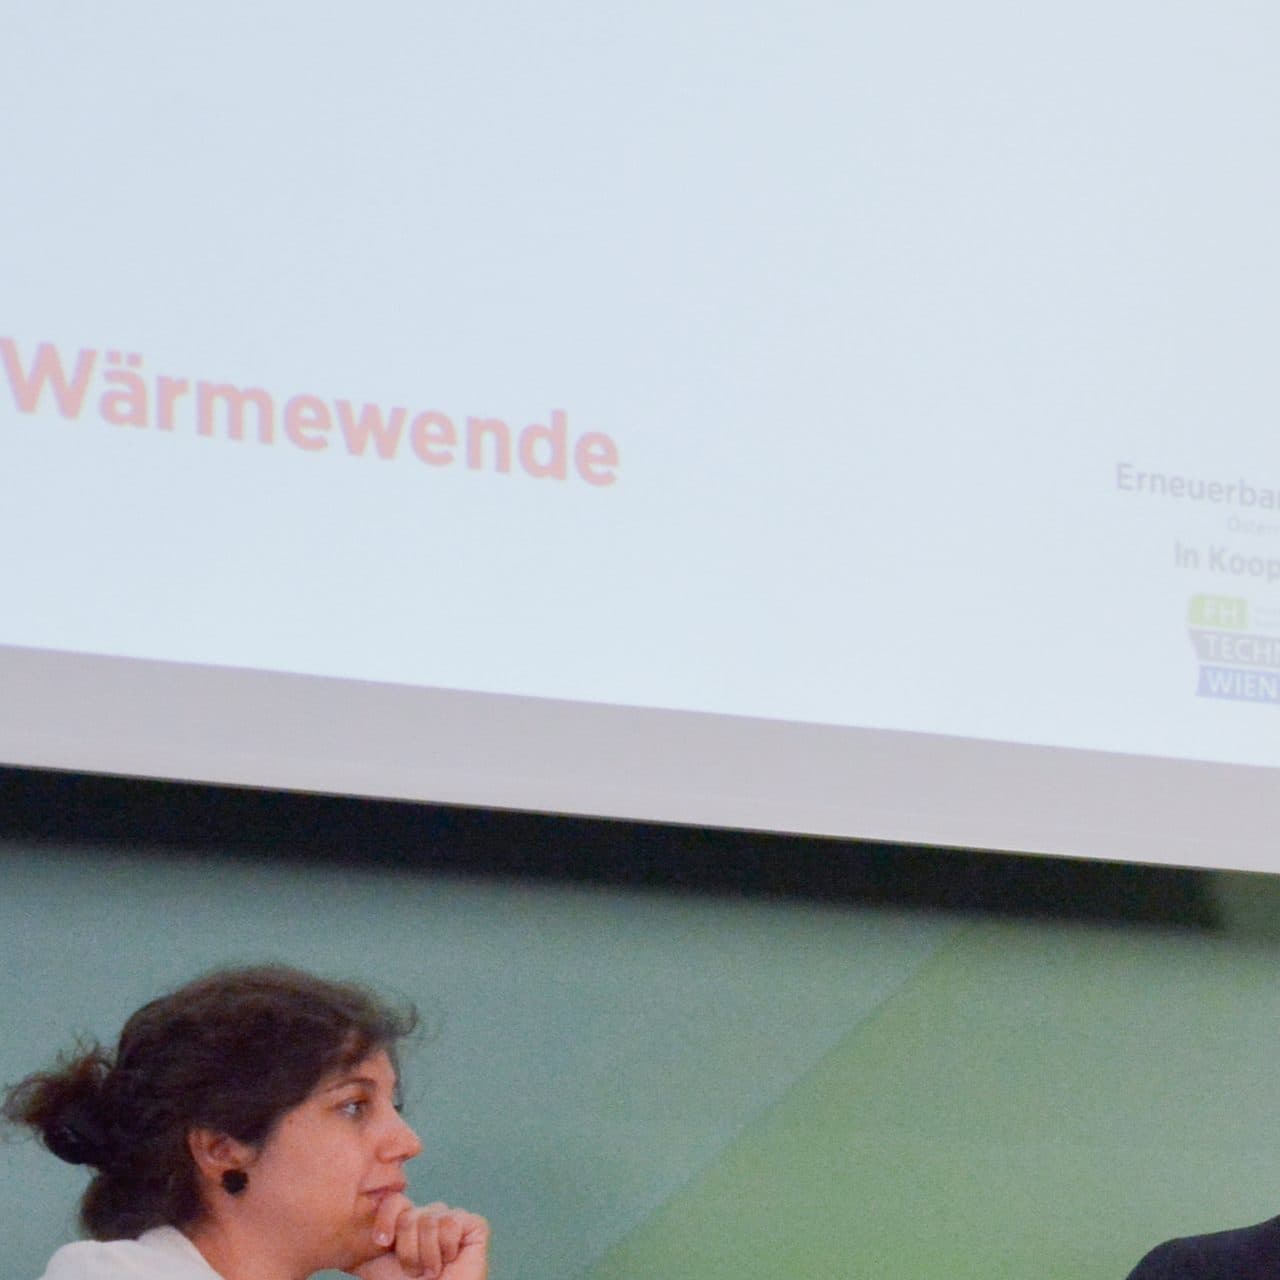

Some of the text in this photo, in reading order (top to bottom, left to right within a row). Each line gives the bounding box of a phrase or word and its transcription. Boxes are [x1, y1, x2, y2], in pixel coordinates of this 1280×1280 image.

[0, 335, 620, 488] Wärmewende
[1203, 597, 1238, 626] FH
[1206, 669, 1278, 699] WIEN
